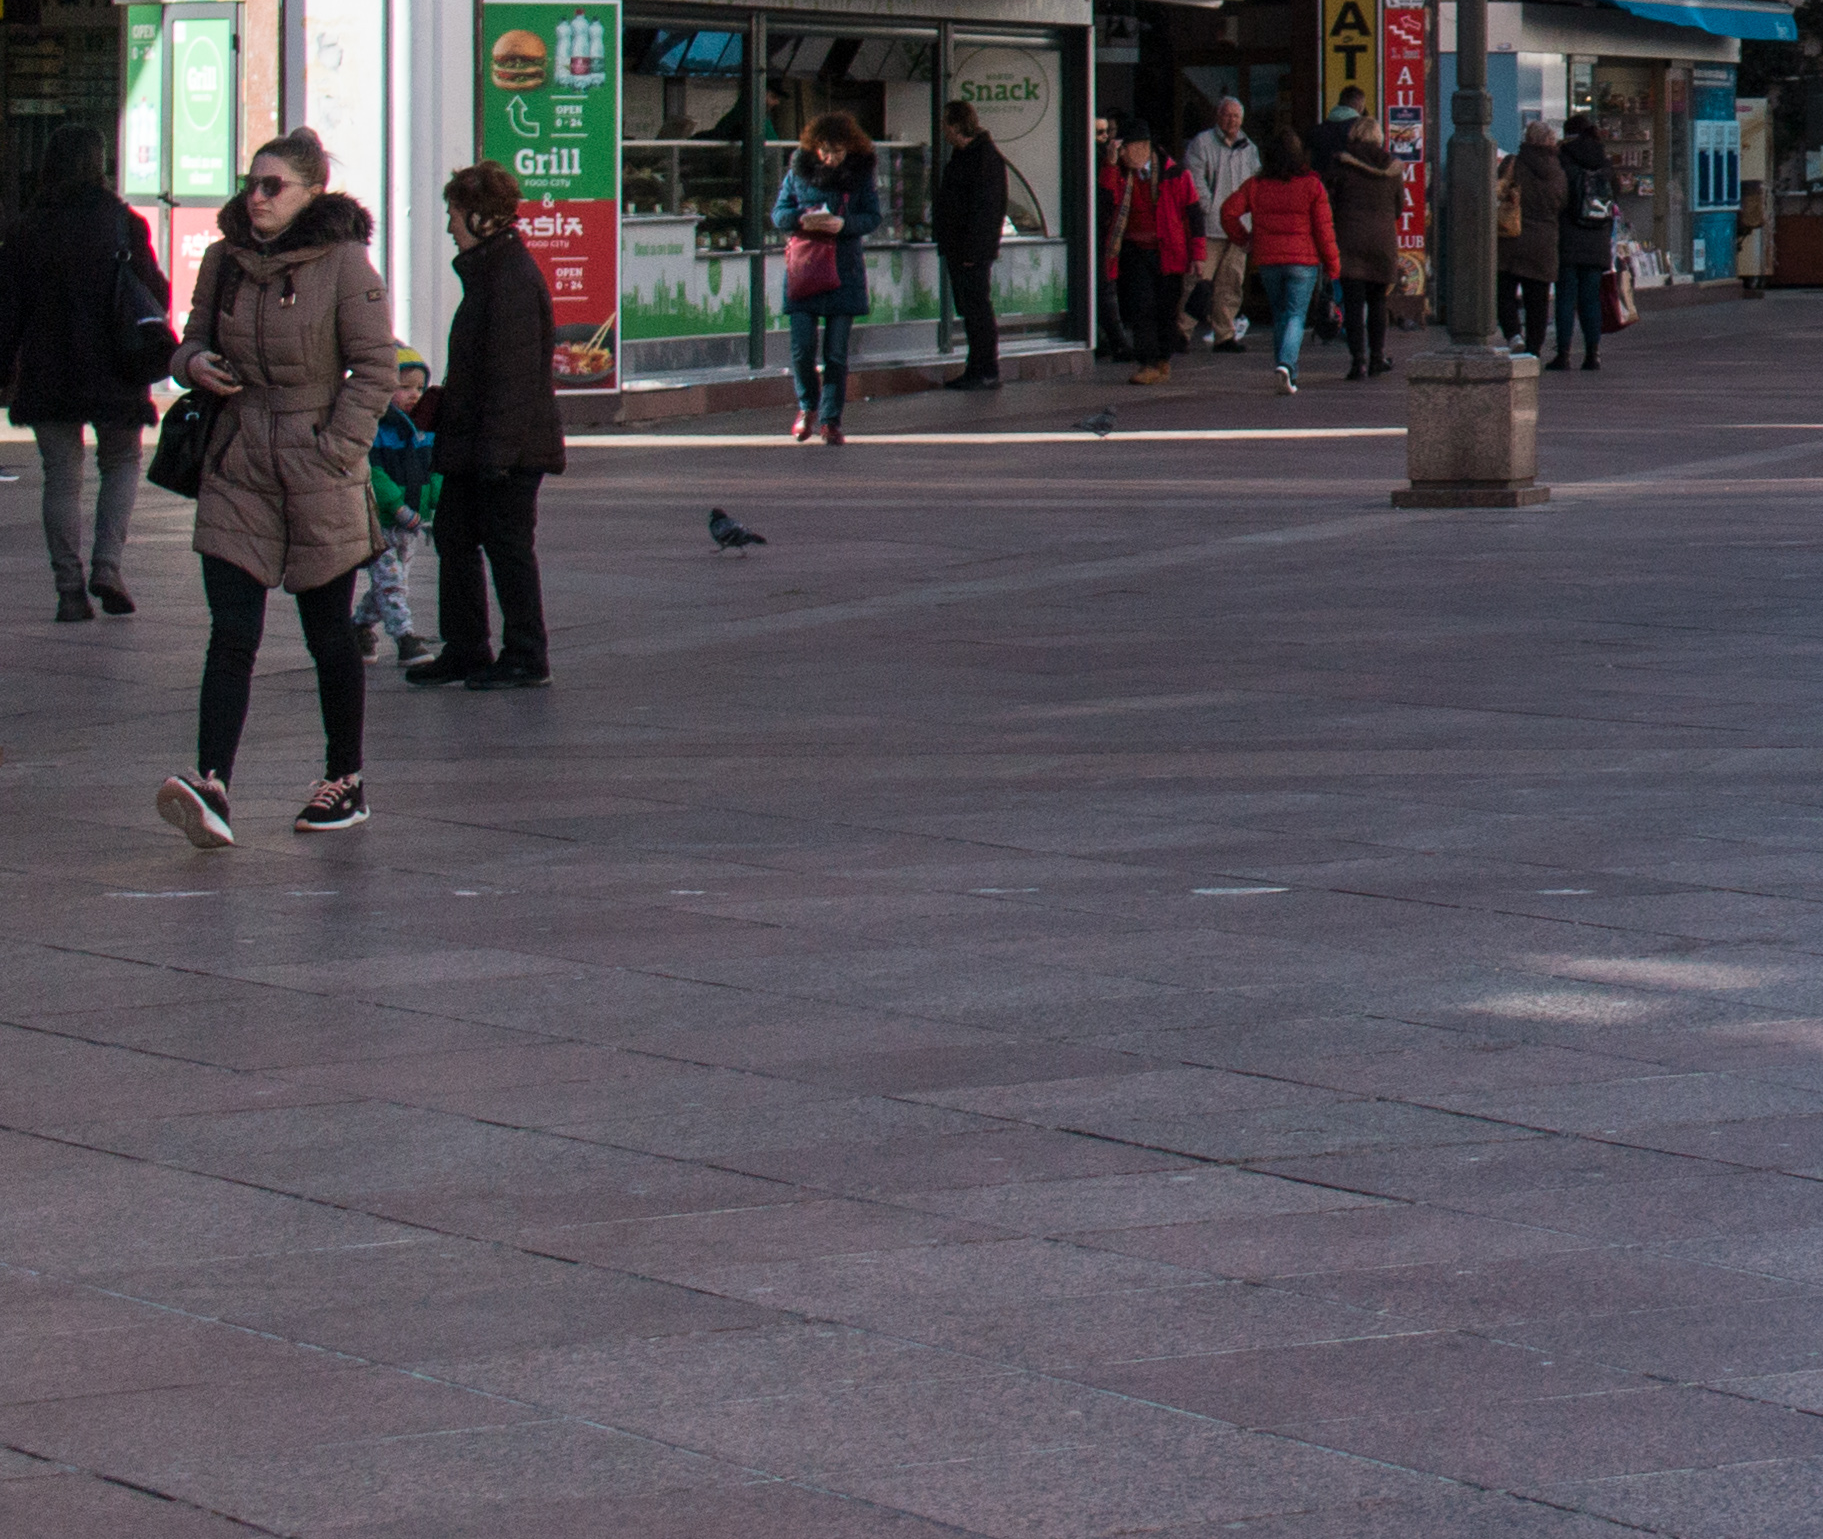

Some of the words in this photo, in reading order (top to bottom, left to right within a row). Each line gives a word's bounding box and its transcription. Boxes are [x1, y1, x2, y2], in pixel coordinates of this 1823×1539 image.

[961, 76, 1040, 101] Snack
[556, 105, 583, 114] OPEN
[514, 147, 581, 175] Grill
[525, 179, 548, 187] FOOD
[551, 179, 571, 188] CITY
[542, 192, 555, 208] &
[527, 240, 549, 248] FOOD
[1397, 235, 1424, 249] LUB
[556, 267, 583, 277] OPEN
